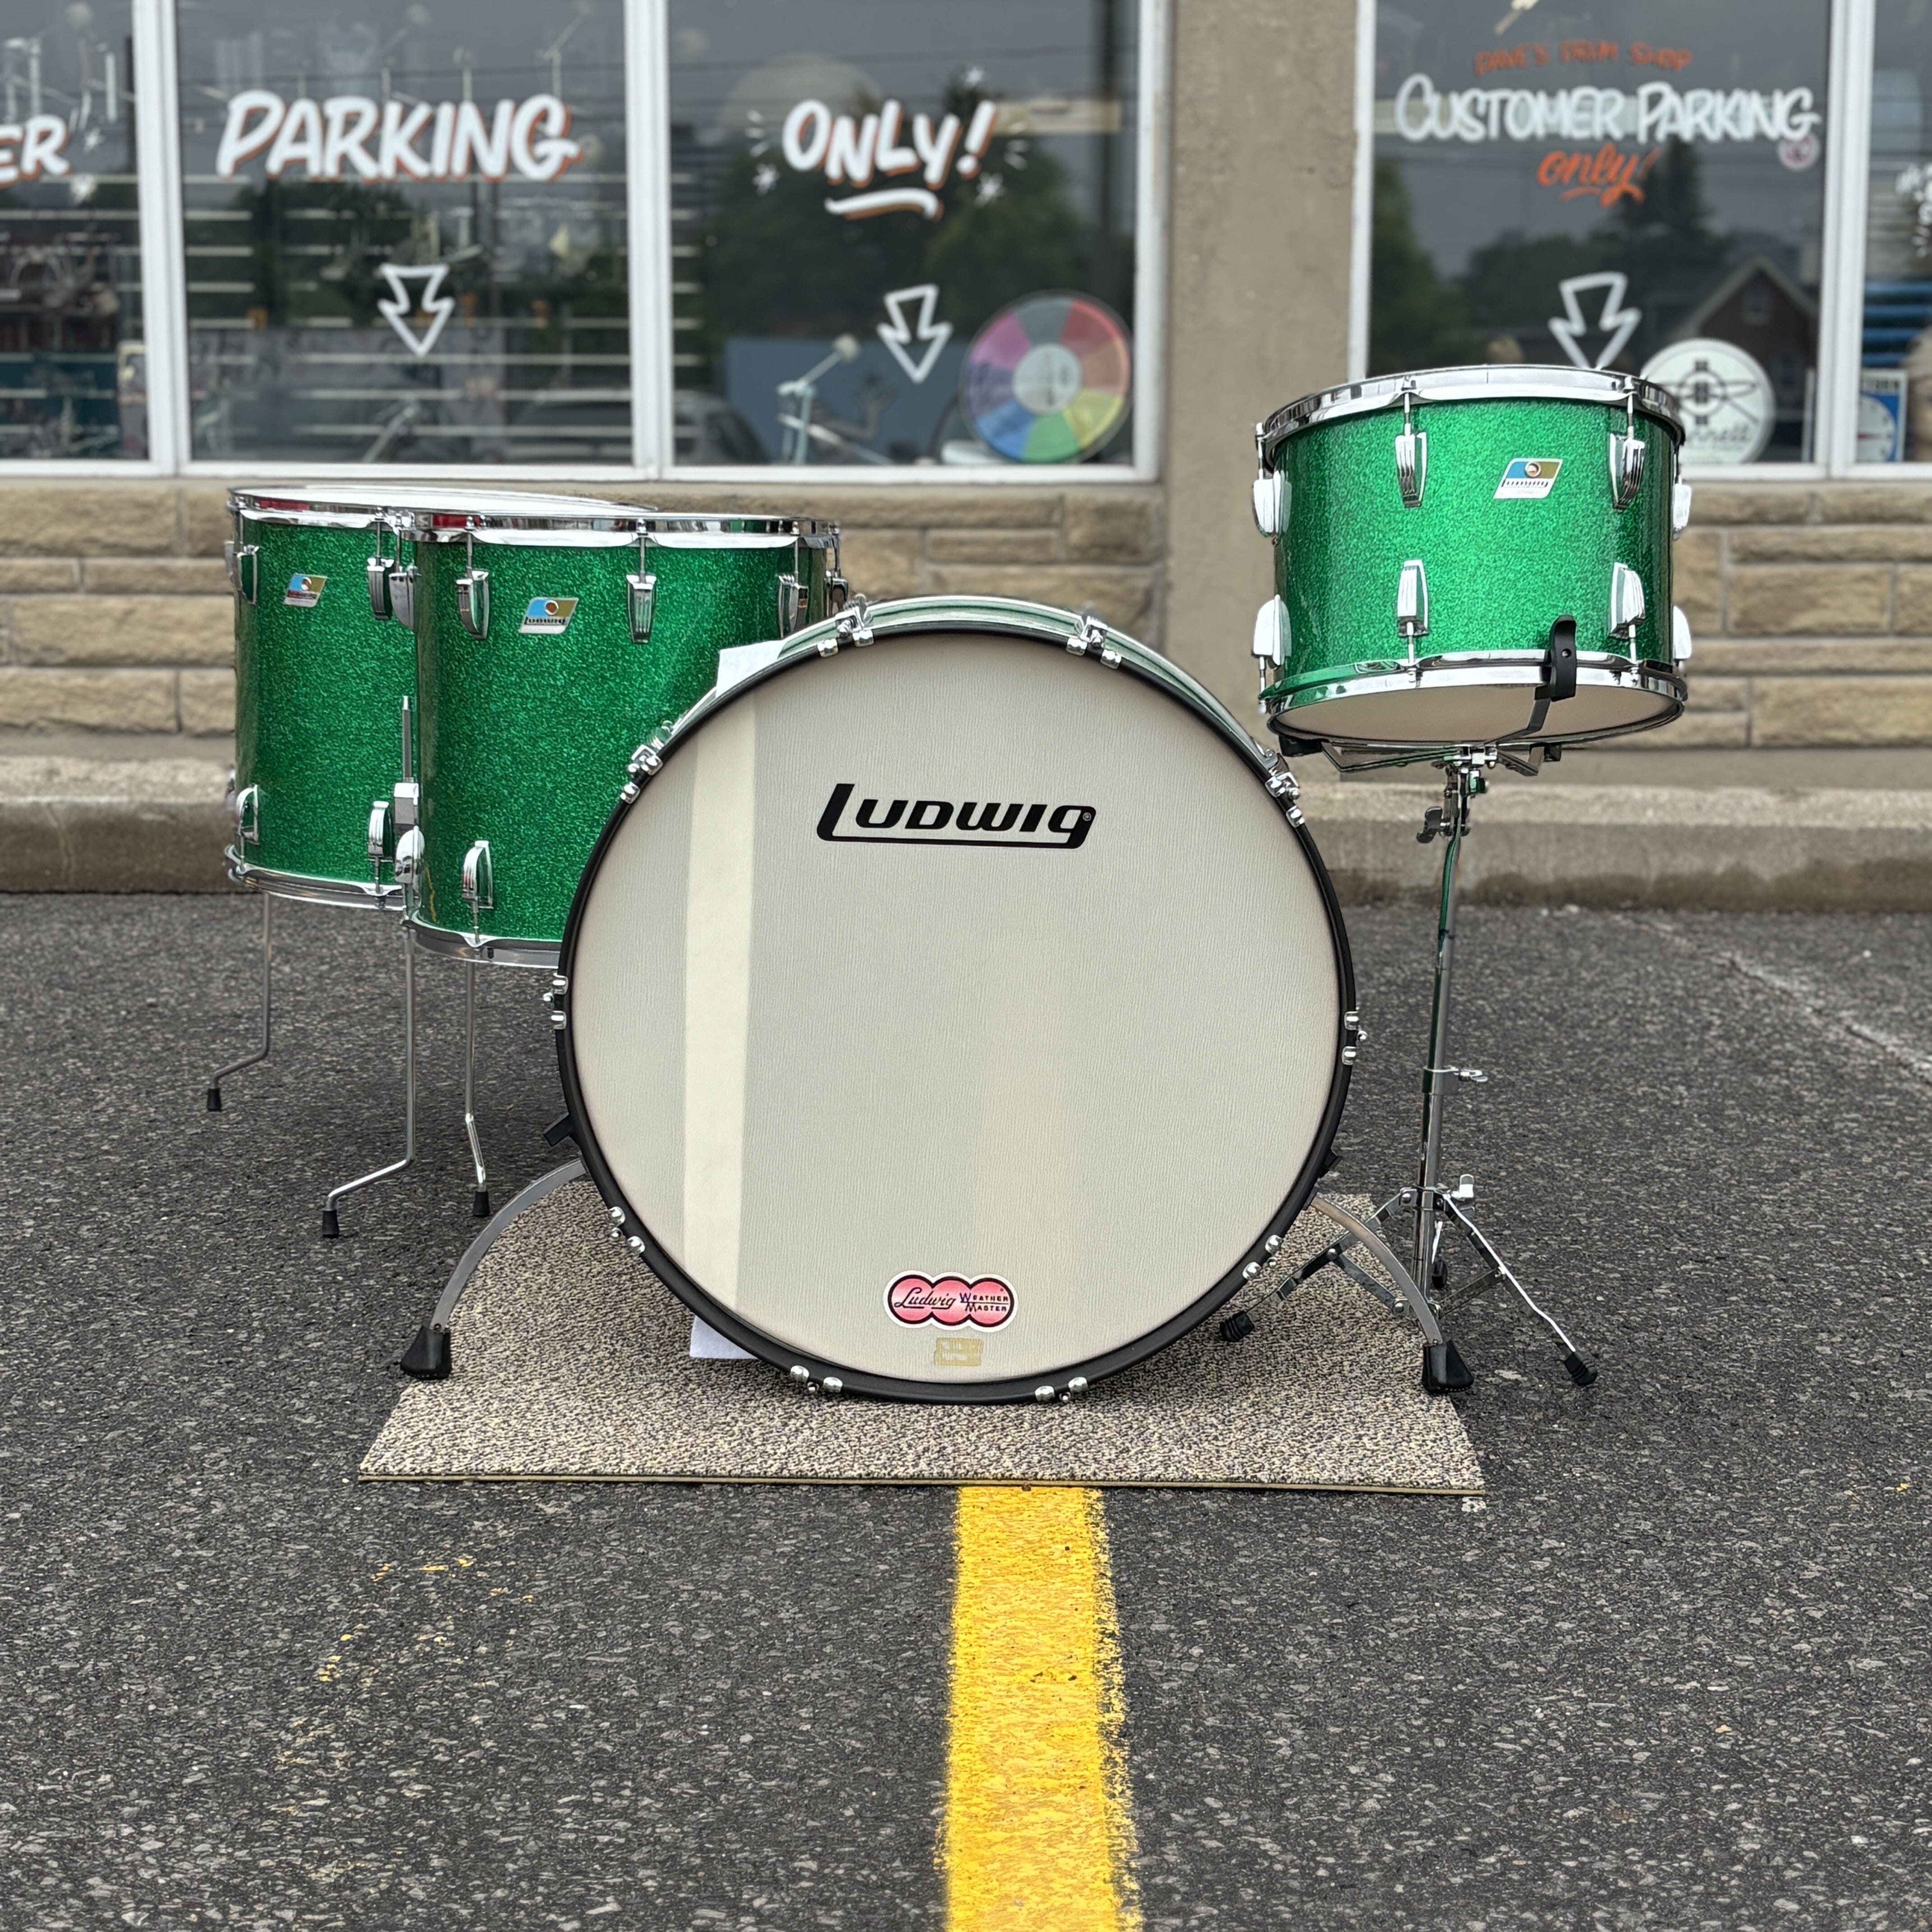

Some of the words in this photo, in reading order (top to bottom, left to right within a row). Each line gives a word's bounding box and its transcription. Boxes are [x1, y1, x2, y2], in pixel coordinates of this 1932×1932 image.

[1629, 41, 1692, 72] SHOP
[1395, 74, 1624, 143] CUSTOMER
[1637, 81, 1822, 144] PARKING
[216, 89, 582, 184] PARKING
[782, 99, 999, 190] ONLY!
[894, 1287, 957, 1310] Ludwig
